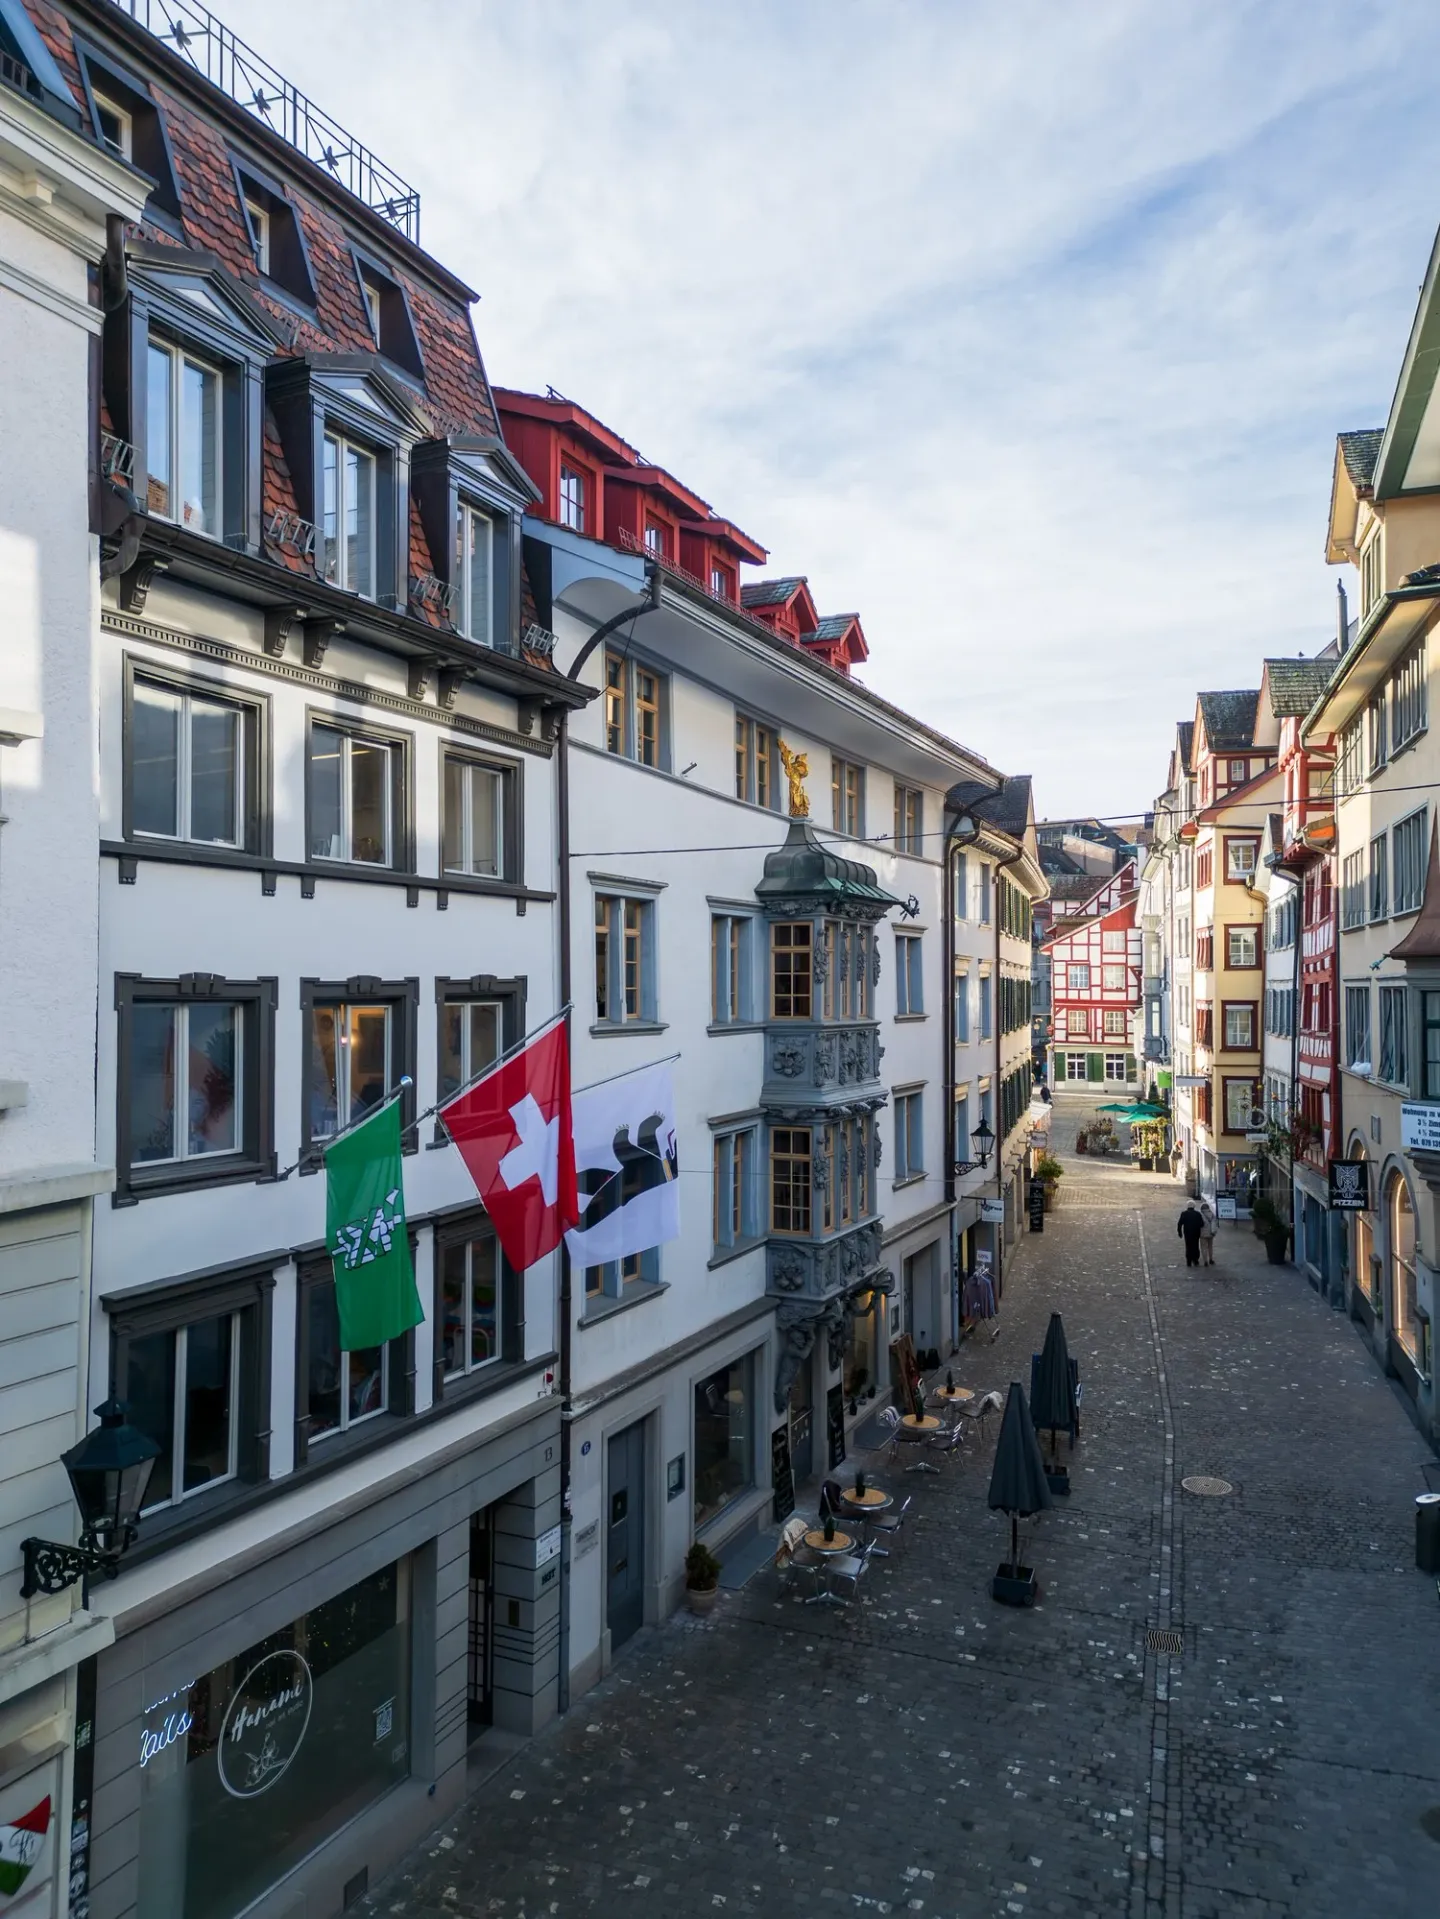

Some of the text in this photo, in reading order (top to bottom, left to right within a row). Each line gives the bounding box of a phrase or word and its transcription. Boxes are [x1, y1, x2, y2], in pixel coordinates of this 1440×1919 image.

[1402, 1108, 1427, 1117] Wohnung
[1410, 1137, 1420, 1145] Tel.
[545, 1447, 552, 1461] 13
[231, 1680, 303, 1742] Hanami
